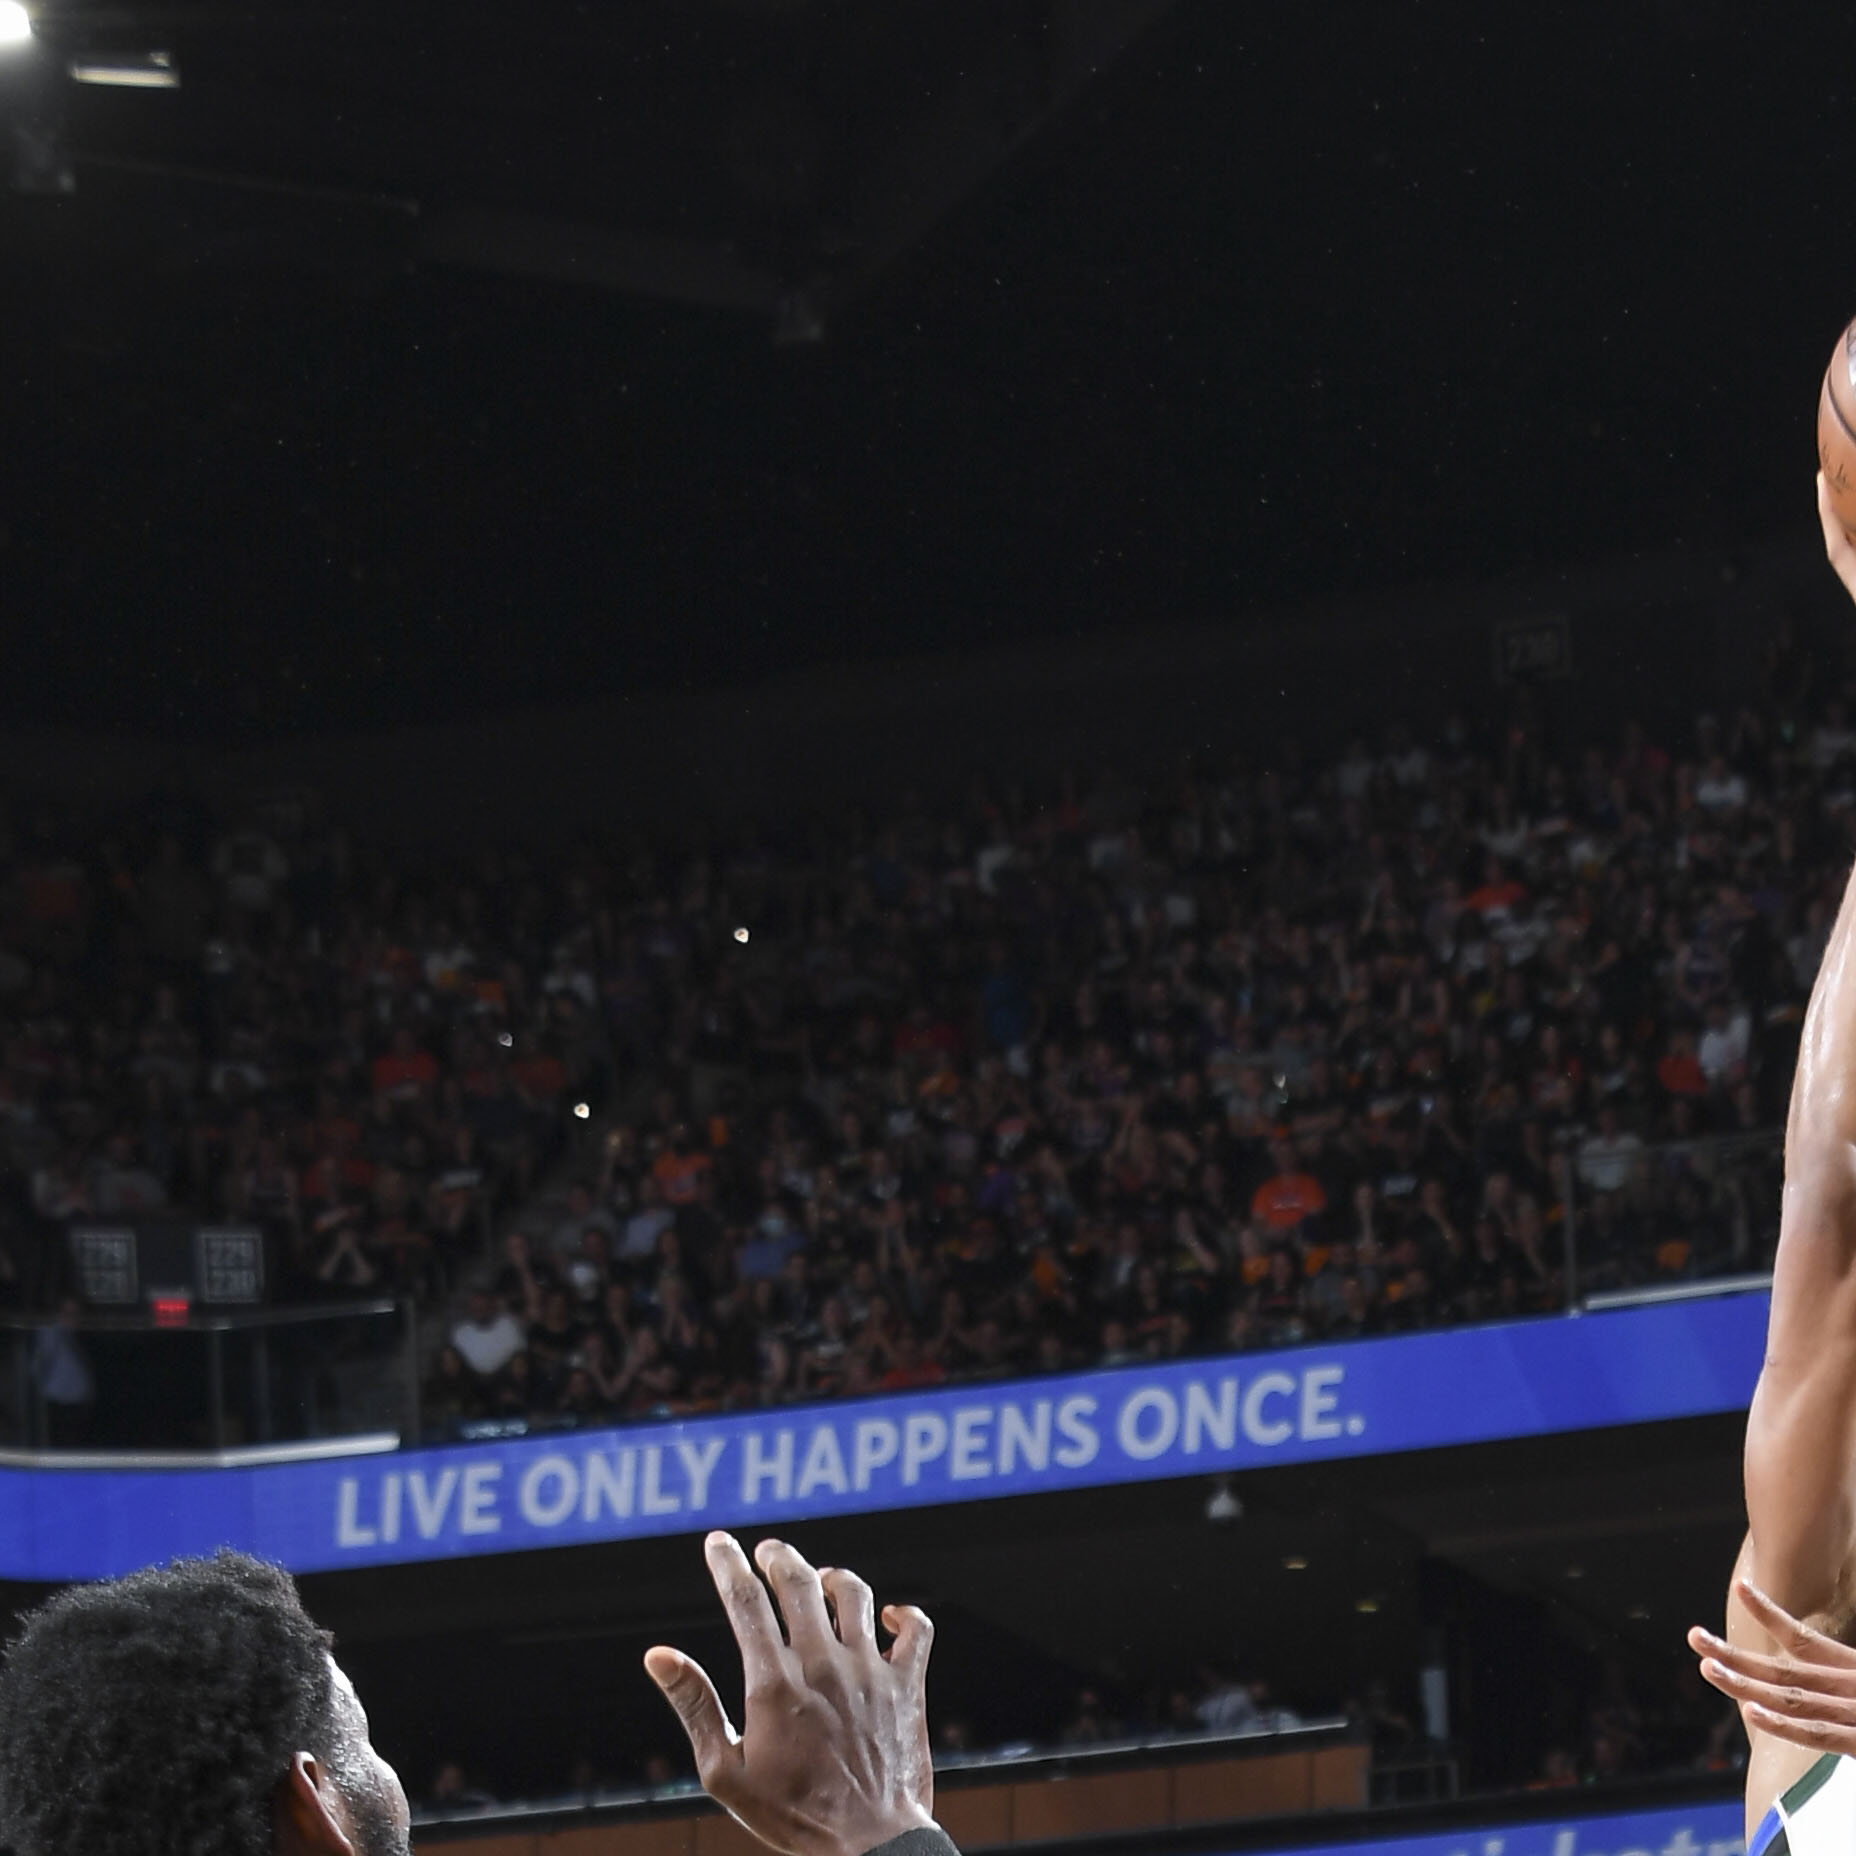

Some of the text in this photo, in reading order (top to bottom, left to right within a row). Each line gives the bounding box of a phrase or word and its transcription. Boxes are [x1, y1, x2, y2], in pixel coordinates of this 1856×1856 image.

[337, 1364, 1366, 1548] LIVE ONLY HAPPENS ONCE.
